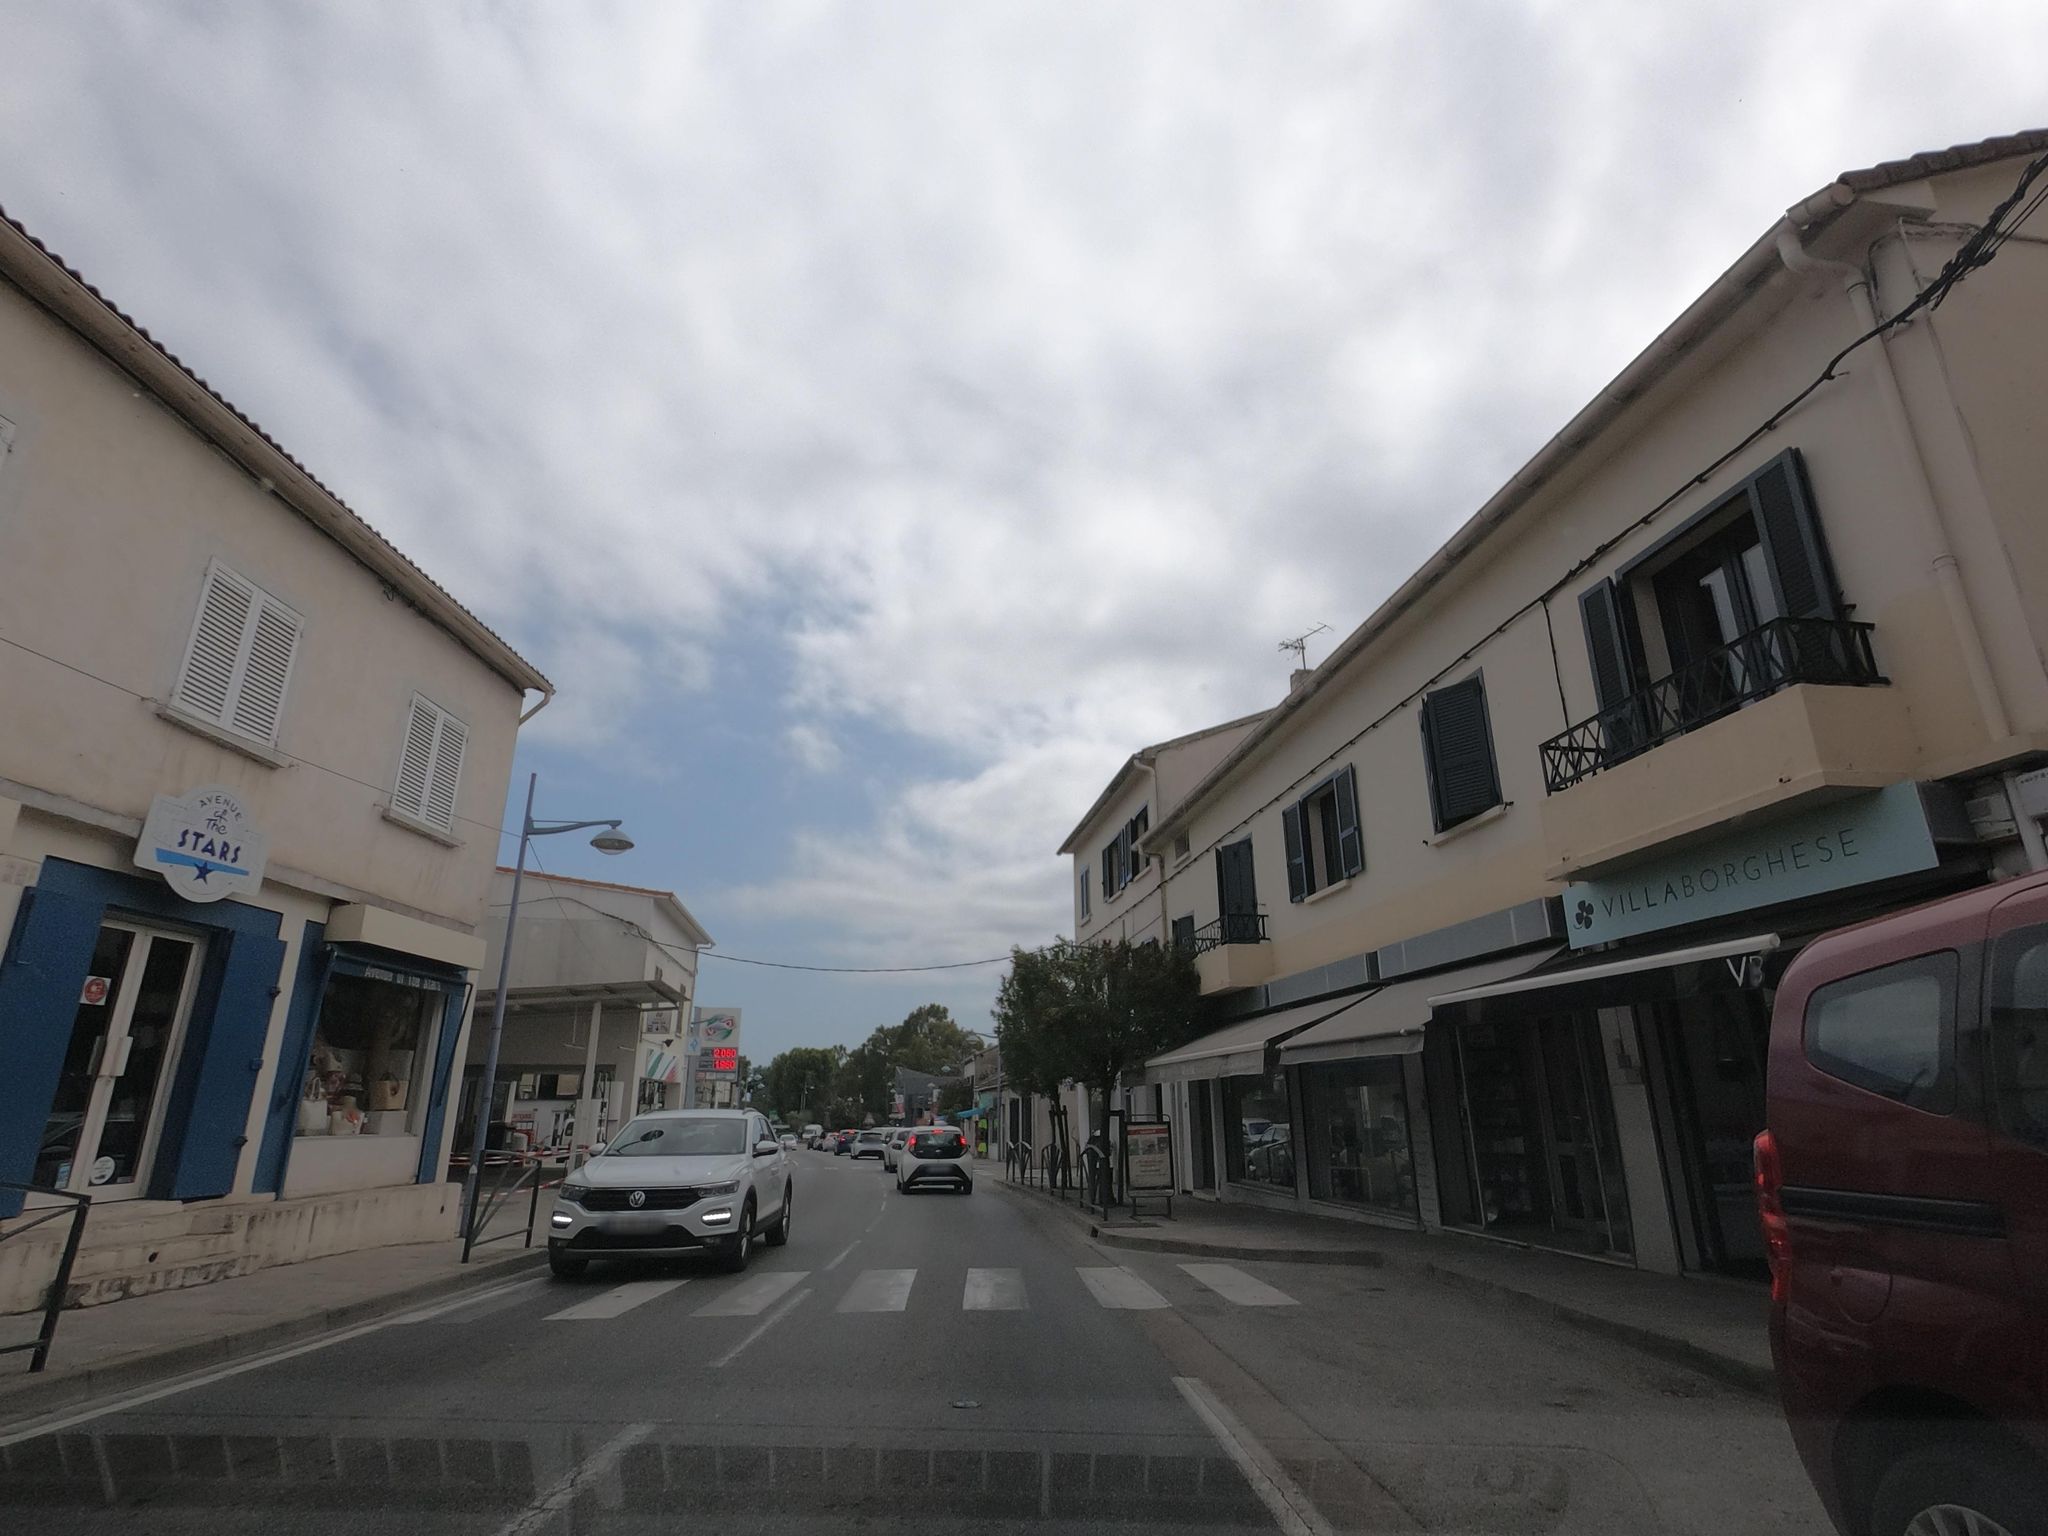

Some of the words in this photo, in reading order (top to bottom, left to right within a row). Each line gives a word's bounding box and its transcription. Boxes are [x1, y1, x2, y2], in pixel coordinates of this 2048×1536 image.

[199, 795, 242, 821] AVENUE
[177, 829, 241, 863] STARS
[1601, 828, 1859, 918] VILLABORGHESE
